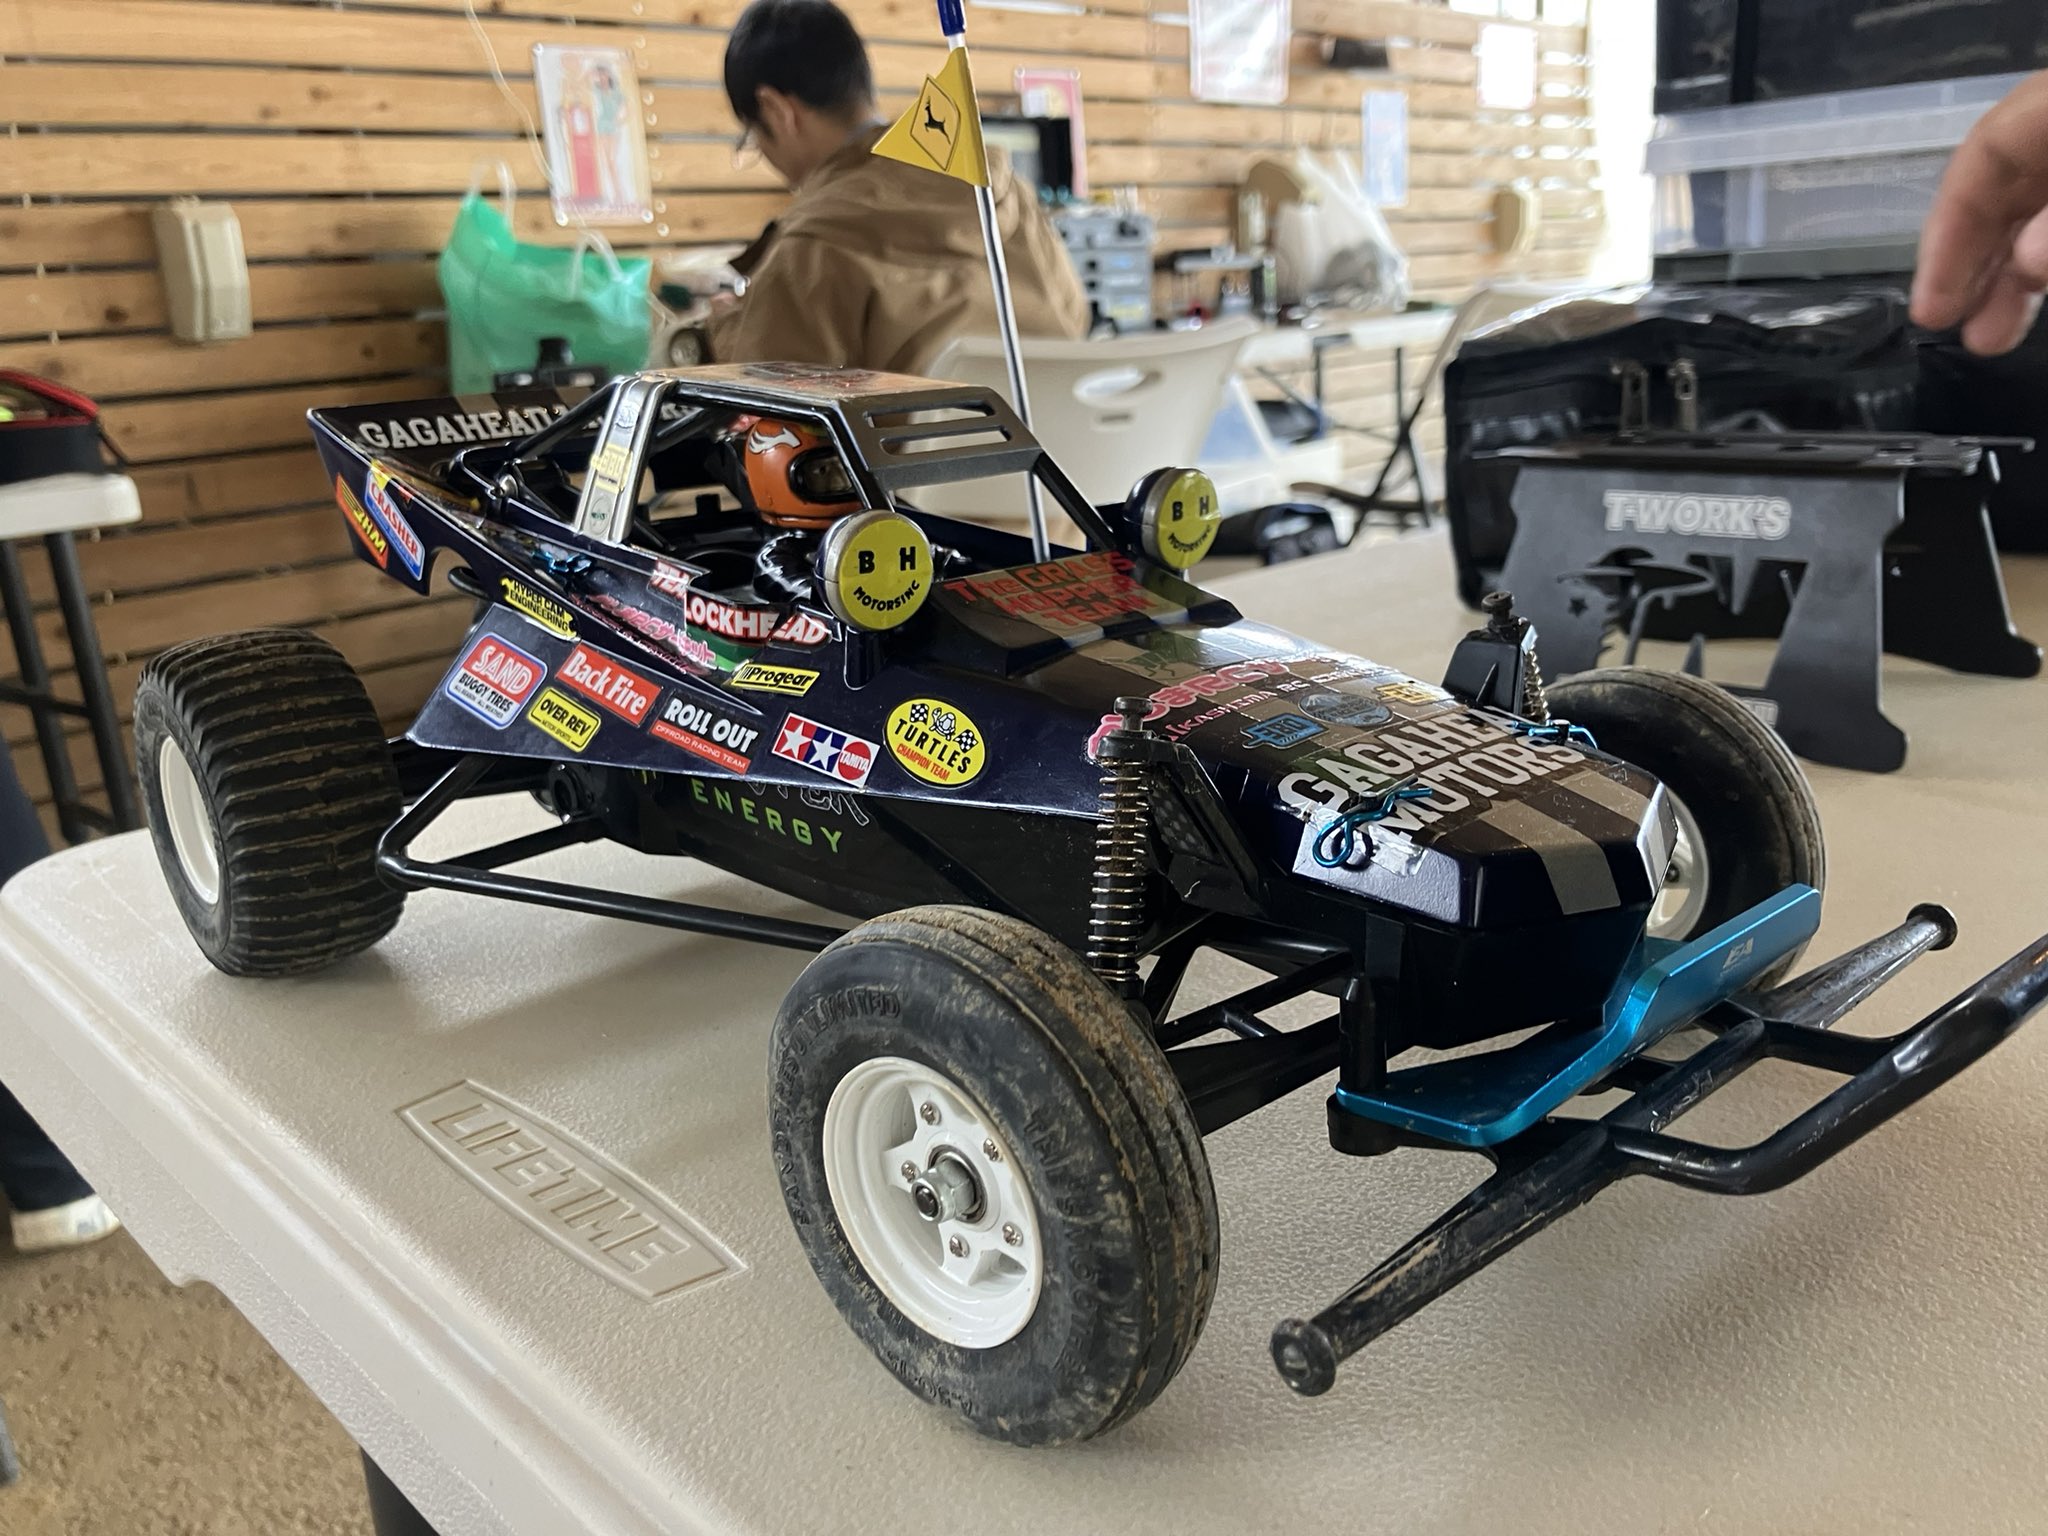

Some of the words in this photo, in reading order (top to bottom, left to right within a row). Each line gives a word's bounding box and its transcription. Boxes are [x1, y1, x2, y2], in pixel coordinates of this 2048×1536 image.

[357, 404, 554, 450] GAGAHEAD
[1172, 501, 1183, 521] B
[1603, 490, 1791, 540] T-WORK'S
[858, 550, 875, 574] B
[899, 546, 916, 571] H
[1014, 551, 1136, 589] GRASS
[510, 589, 570, 632] ENGINEERING
[994, 573, 1143, 619] HOPPER
[1043, 594, 1158, 626] TEAM
[471, 644, 534, 696] SAND
[563, 650, 609, 696] Back
[605, 672, 648, 717] Fire
[459, 672, 490, 698] BUGGY
[487, 691, 514, 714] TIRES
[540, 698, 571, 725] OVER
[565, 713, 592, 737] REV
[664, 698, 713, 735] ROLL
[712, 718, 759, 753] OUT
[655, 725, 691, 744] OFFROAD
[691, 740, 721, 758] RACING
[722, 753, 745, 768] TEAM
[839, 750, 869, 774] TAMIYA
[894, 718, 972, 774] TURTLES
[896, 743, 931, 770] CHAMPION
[930, 760, 951, 781] TEAM
[1277, 705, 1520, 812] GAGAHEA
[691, 777, 843, 853] ENERGY
[430, 1102, 693, 1275] LIFETIME
